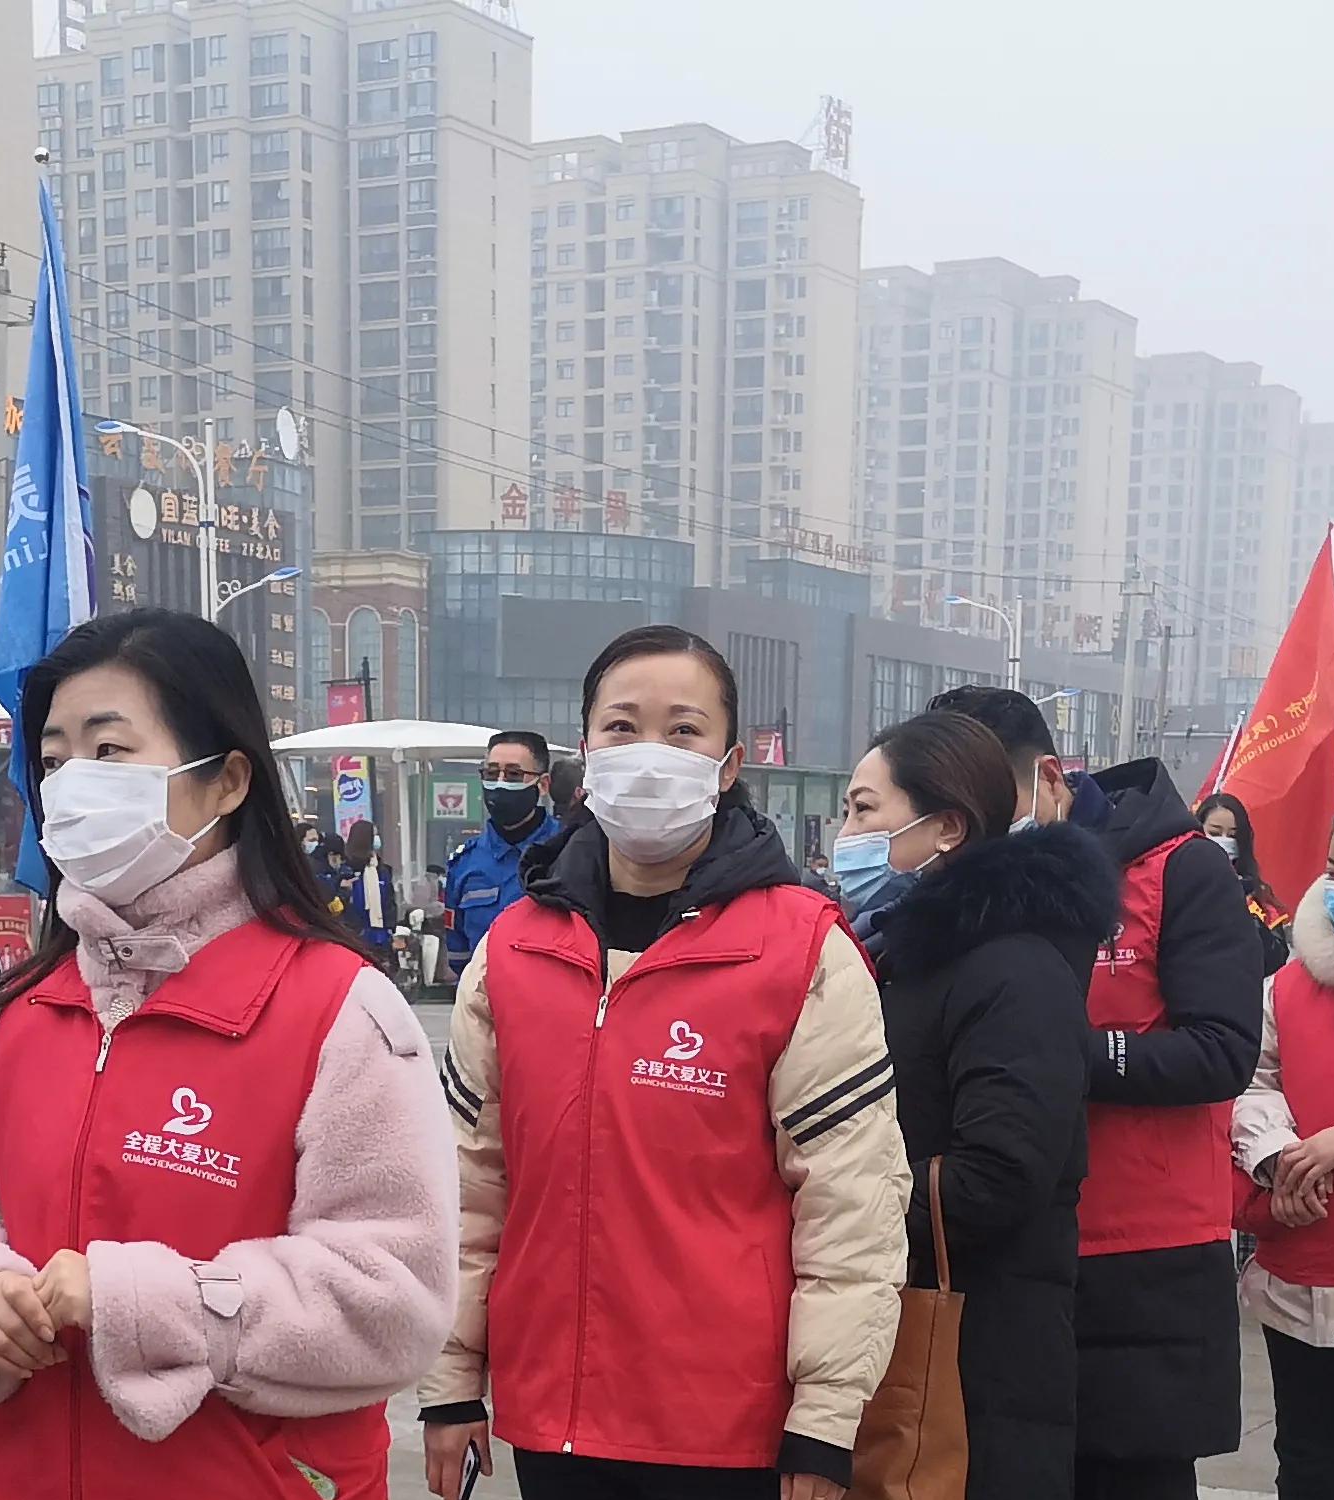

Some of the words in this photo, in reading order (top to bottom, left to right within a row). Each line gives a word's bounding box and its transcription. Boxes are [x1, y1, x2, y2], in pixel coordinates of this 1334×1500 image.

[632, 1058, 727, 1087] 全程大爱义工
[123, 1130, 240, 1174] 全程大爱义工
